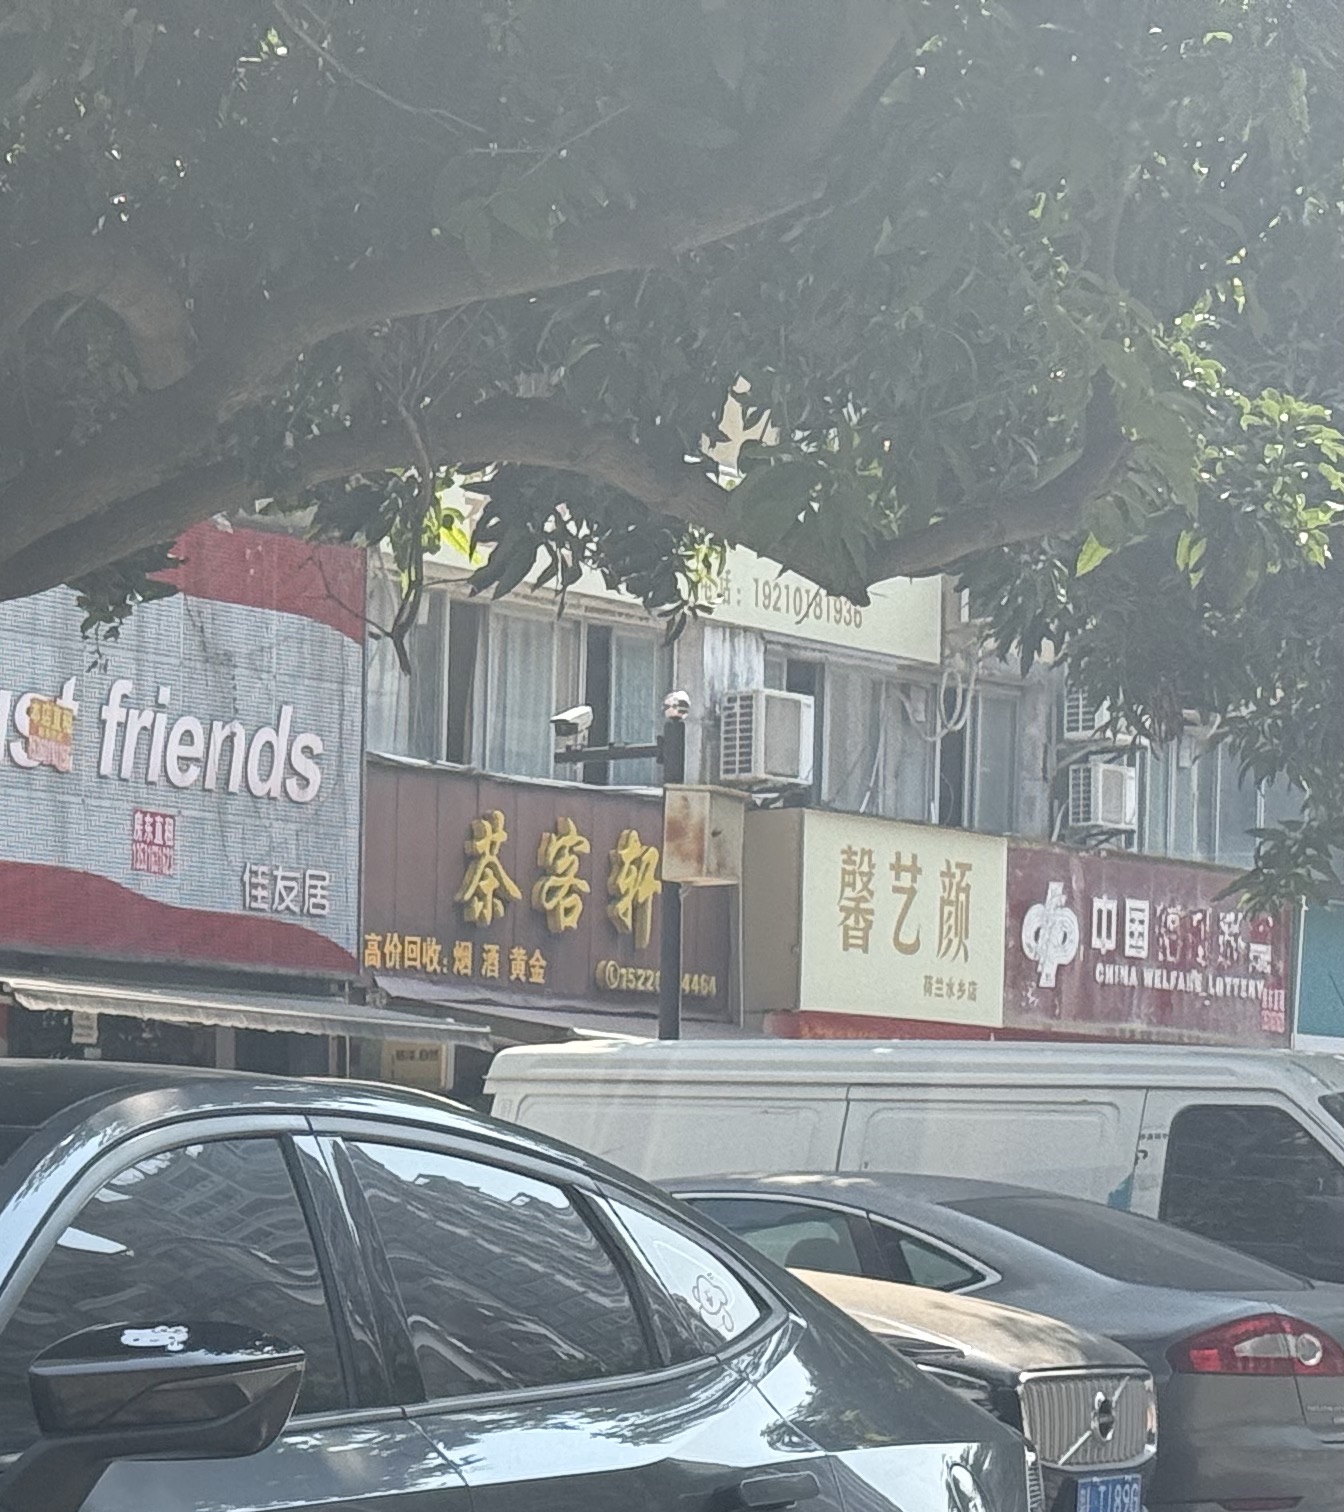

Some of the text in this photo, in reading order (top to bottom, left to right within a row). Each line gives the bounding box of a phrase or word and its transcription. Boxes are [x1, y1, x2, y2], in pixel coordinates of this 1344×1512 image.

[98, 677, 325, 803] friends
[242, 862, 330, 915] 佳友居
[455, 809, 662, 950] 茶客轩
[838, 843, 972, 965] 馨艺颜
[509, 946, 548, 986] 黄金
[923, 974, 978, 1002] 荷兰水乡店
[1095, 962, 1139, 986] CHINA
[1208, 972, 1265, 1001] LOTTERY
